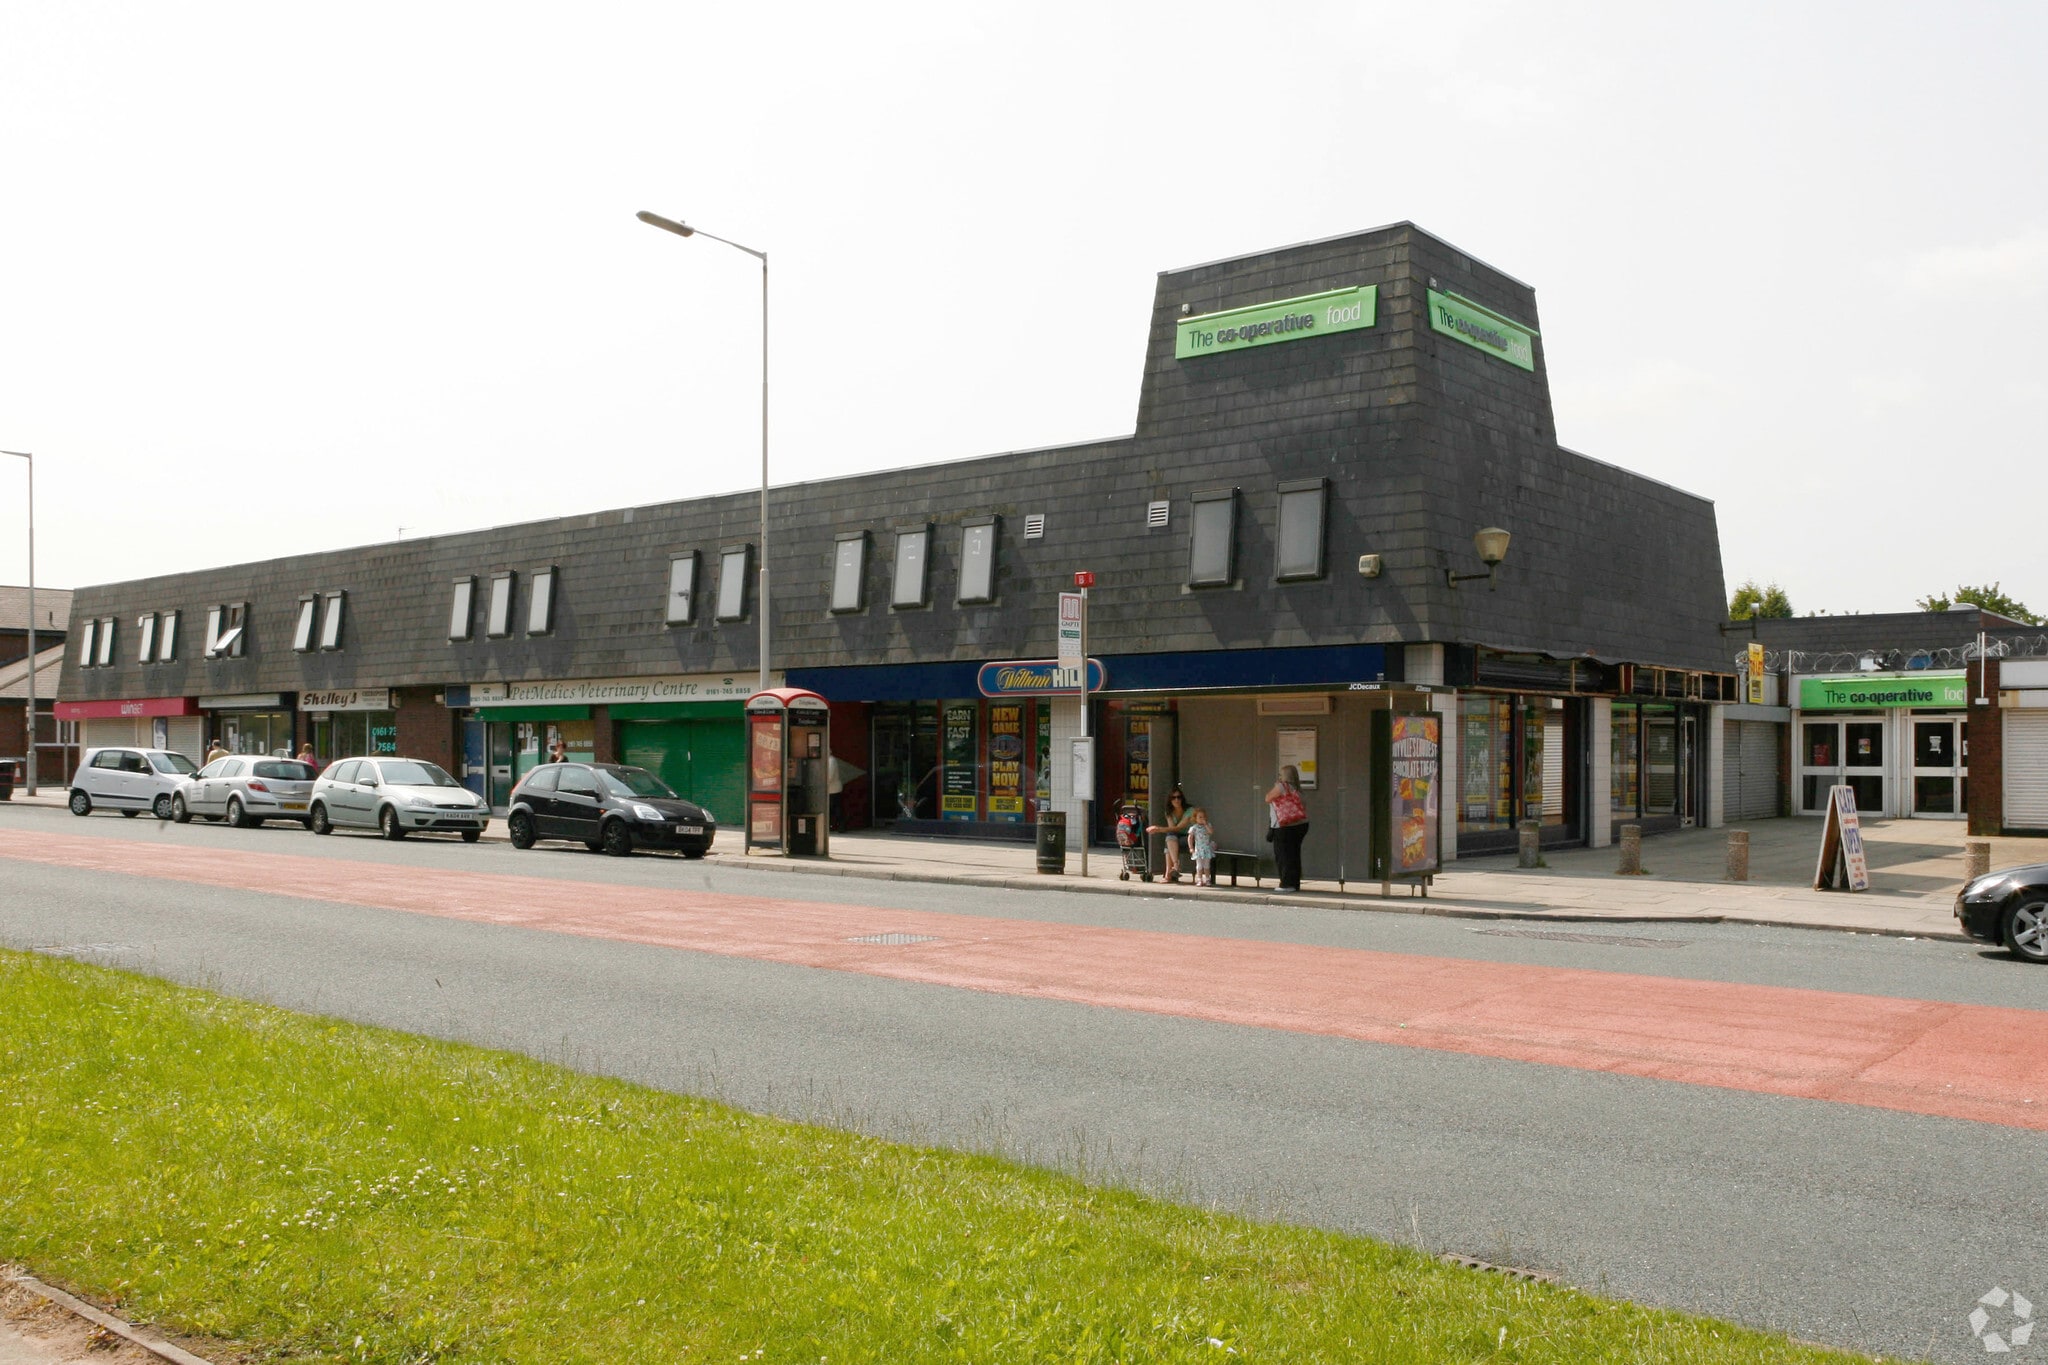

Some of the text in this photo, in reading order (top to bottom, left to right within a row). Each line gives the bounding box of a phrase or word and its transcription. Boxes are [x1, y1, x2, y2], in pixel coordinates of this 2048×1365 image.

[1189, 301, 1361, 349] The co-operative food
[1438, 305, 1454, 329] The
[1510, 338, 1528, 362] food
[996, 667, 1052, 690] William
[577, 680, 649, 701] Veterinary
[652, 681, 699, 697] Centre
[1825, 690, 1846, 703] The
[1850, 689, 1933, 704] co-operative
[303, 692, 357, 708] Shelley's
[947, 710, 971, 720] EARN
[993, 707, 1019, 721] NEW
[947, 727, 970, 738] FAST
[993, 722, 1019, 734] GAME
[993, 761, 1019, 772] PLAY
[992, 773, 1019, 787] NOW
[1130, 775, 1149, 790] NO
[1844, 827, 1863, 855] OPEN
